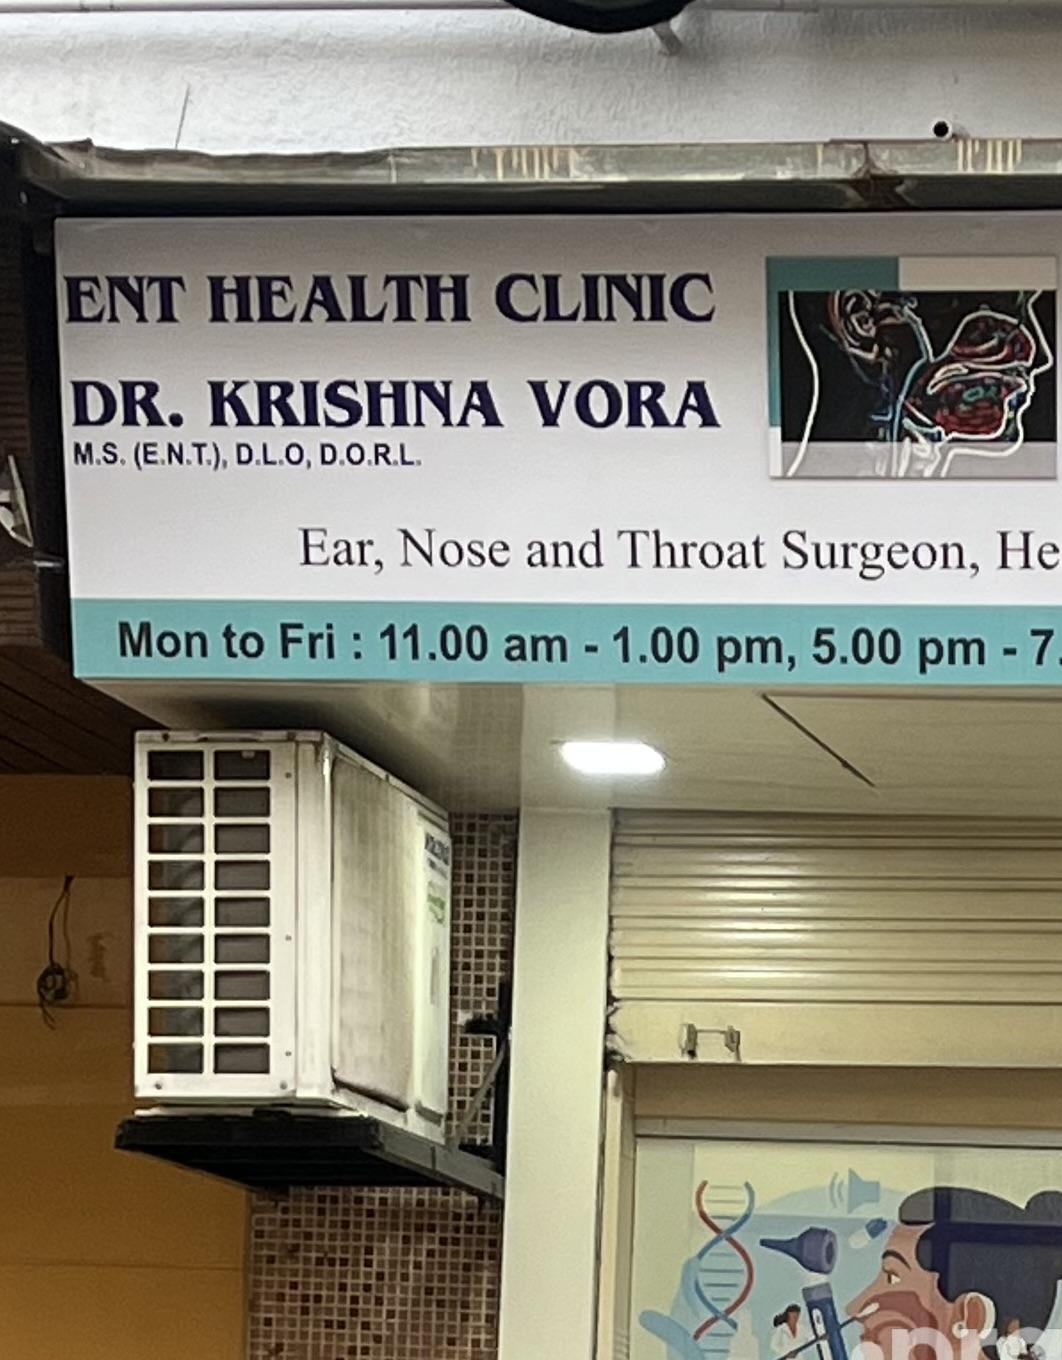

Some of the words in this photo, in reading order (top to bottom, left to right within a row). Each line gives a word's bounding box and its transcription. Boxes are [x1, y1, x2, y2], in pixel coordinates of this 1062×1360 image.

[64, 275, 186, 322] ENT
[209, 274, 470, 322] HEALTH
[495, 273, 716, 324] CLINIC
[71, 380, 185, 428] DR.
[209, 380, 503, 428] KRISHNA
[528, 380, 720, 429] VORA
[73, 442, 127, 466] M.S.
[134, 442, 229, 471] (E.N.T.),
[236, 443, 312, 471] D.L.O,
[320, 444, 421, 467] D.O.R.L.
[299, 527, 384, 575] Ear,
[399, 528, 510, 568] Nose
[526, 528, 604, 569] and
[618, 530, 766, 570] Throat
[783, 531, 981, 580] Surgeon,
[118, 621, 209, 659] Mon
[223, 622, 266, 660] to
[280, 623, 336, 660] Fri
[380, 624, 488, 662] 11.00
[504, 634, 567, 663] am
[614, 626, 699, 664] 1.00
[717, 637, 796, 673] pm,
[812, 627, 901, 665] 5.00
[918, 635, 986, 674] pm
